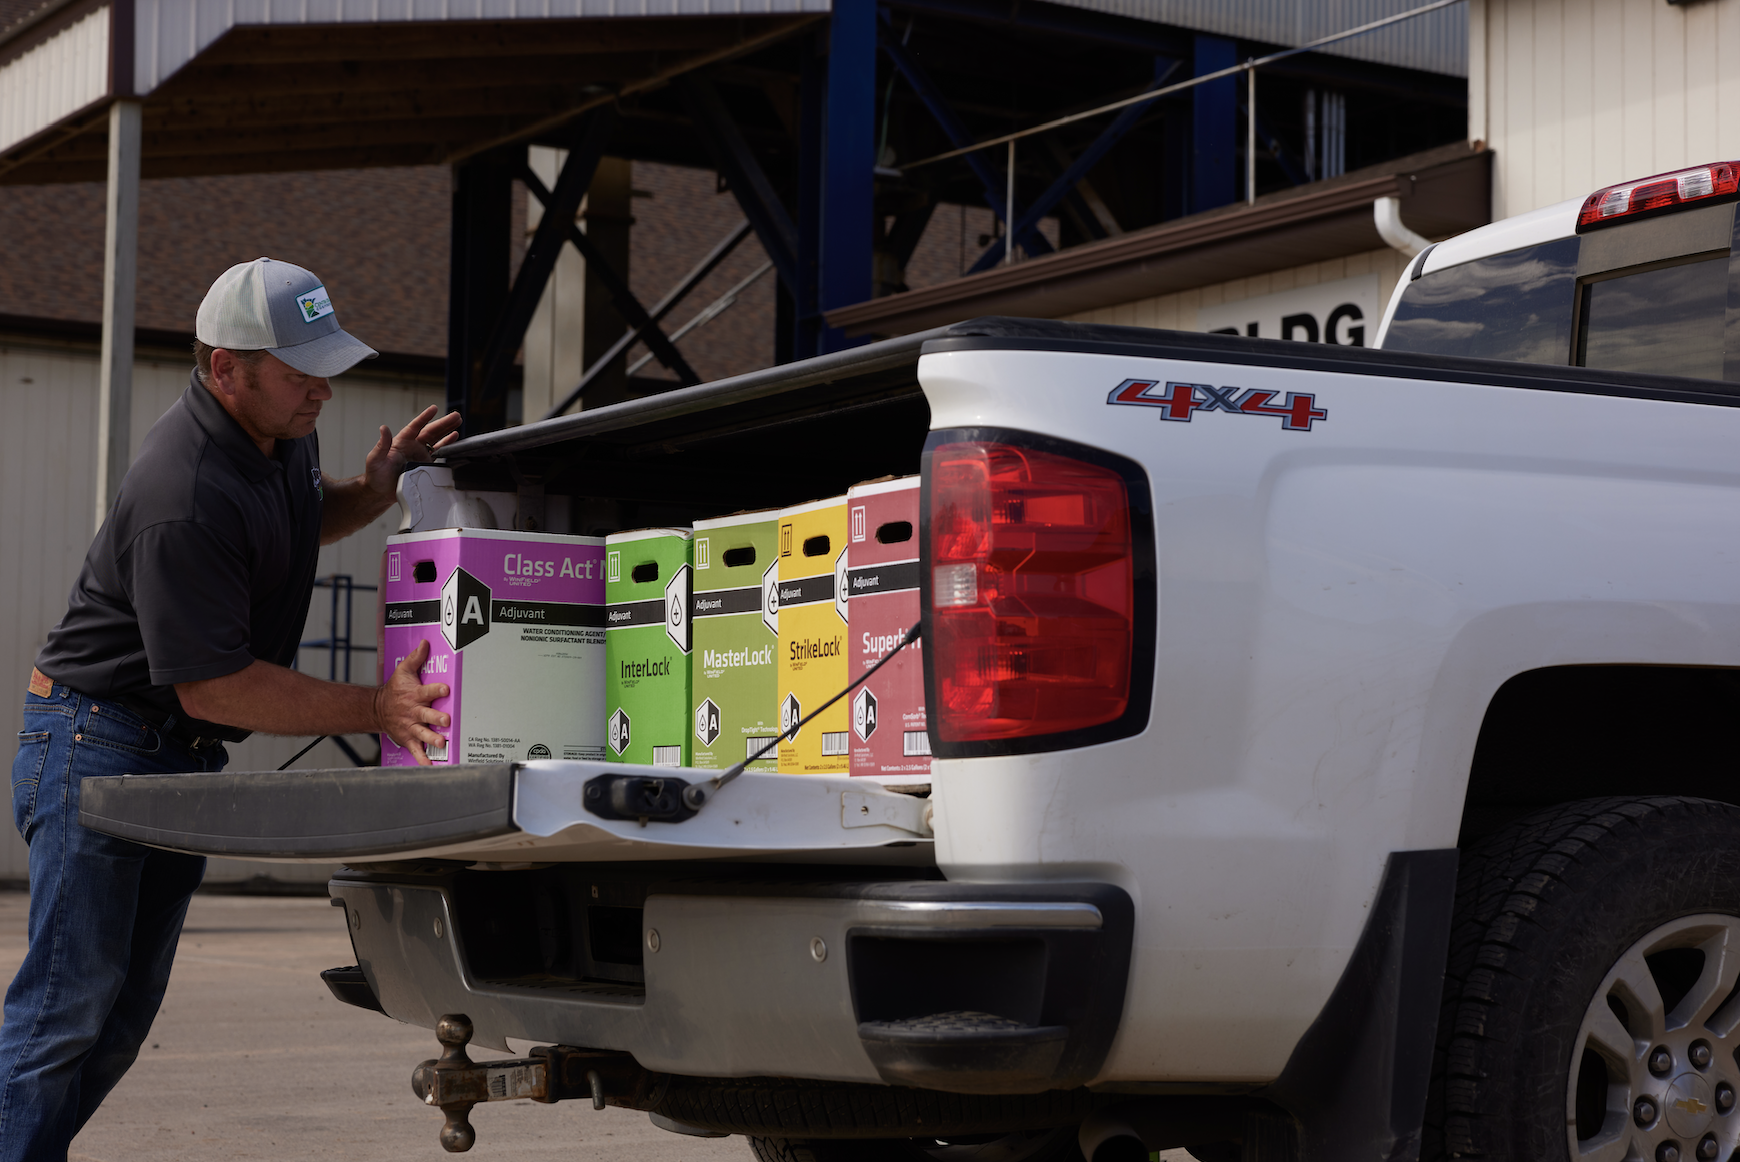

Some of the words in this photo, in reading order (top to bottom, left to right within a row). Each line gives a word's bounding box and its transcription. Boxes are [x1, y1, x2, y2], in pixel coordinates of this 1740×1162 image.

[504, 553, 554, 577] Class
[852, 576, 879, 589] Adjuvant
[780, 586, 802, 600] Adjuvant
[461, 595, 484, 625] A
[696, 599, 722, 611] Adjuvant
[388, 608, 413, 620] Adjuvant
[500, 606, 546, 620] Adjuvant
[608, 610, 631, 622] Adjuvant
[544, 628, 584, 637] CONDITIONING
[791, 708, 798, 726] A
[866, 704, 874, 724] A
[709, 714, 718, 731] A
[620, 723, 628, 740] A
